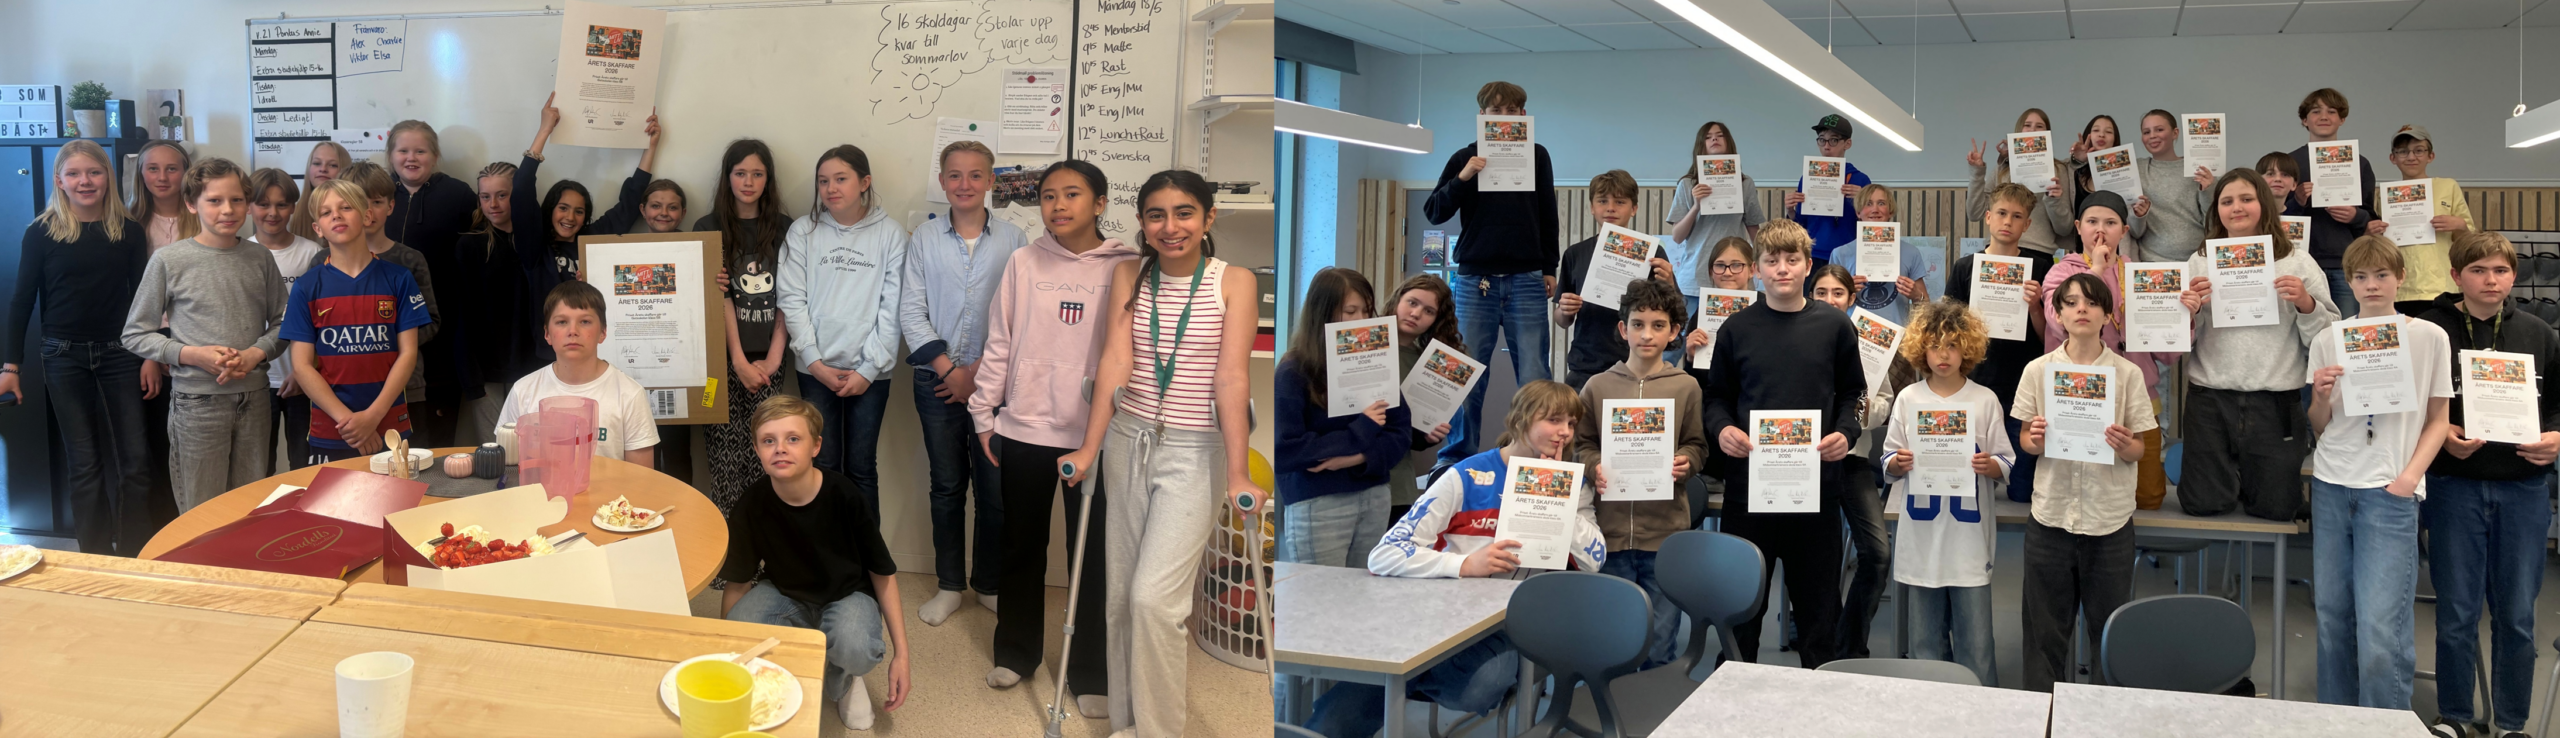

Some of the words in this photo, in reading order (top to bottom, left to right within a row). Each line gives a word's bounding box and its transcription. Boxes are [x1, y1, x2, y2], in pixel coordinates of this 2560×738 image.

[1098, 0, 1136, 16] Måndag
[1140, 0, 1163, 16] 18/5
[898, 12, 910, 30] 16
[984, 16, 1025, 32] Stolar
[1030, 17, 1052, 32] upp
[1104, 20, 1151, 36] Mentorstid
[274, 26, 300, 37] Pontus
[350, 38, 366, 50] Alex
[376, 36, 403, 47] Charlie
[894, 38, 917, 51] kvar
[924, 34, 938, 47] till
[1001, 38, 1030, 54] varje
[1034, 34, 1058, 51] dag
[1104, 40, 1132, 54] Matte
[350, 52, 369, 64] Viktor
[374, 50, 391, 60] Elsa
[588, 59, 607, 67] ÅRETS
[902, 50, 968, 66] sommarlov
[1100, 58, 1126, 73] Rast
[18, 88, 46, 101] SOM
[1100, 82, 1143, 100] Eng/Mu
[18, 106, 22, 118] I
[283, 112, 313, 125] Ledigt!
[1098, 105, 1144, 122] Eng/Mu
[2, 122, 44, 136] BÄST
[1102, 150, 1151, 164] Svenska
[1098, 216, 1124, 230] Rast
[1036, 282, 1111, 294] GANT
[752, 309, 762, 324] OR
[320, 324, 389, 348] QATAR
[337, 343, 390, 353] AIRWAYS
[1360, 352, 1387, 360] SKAFFARE
